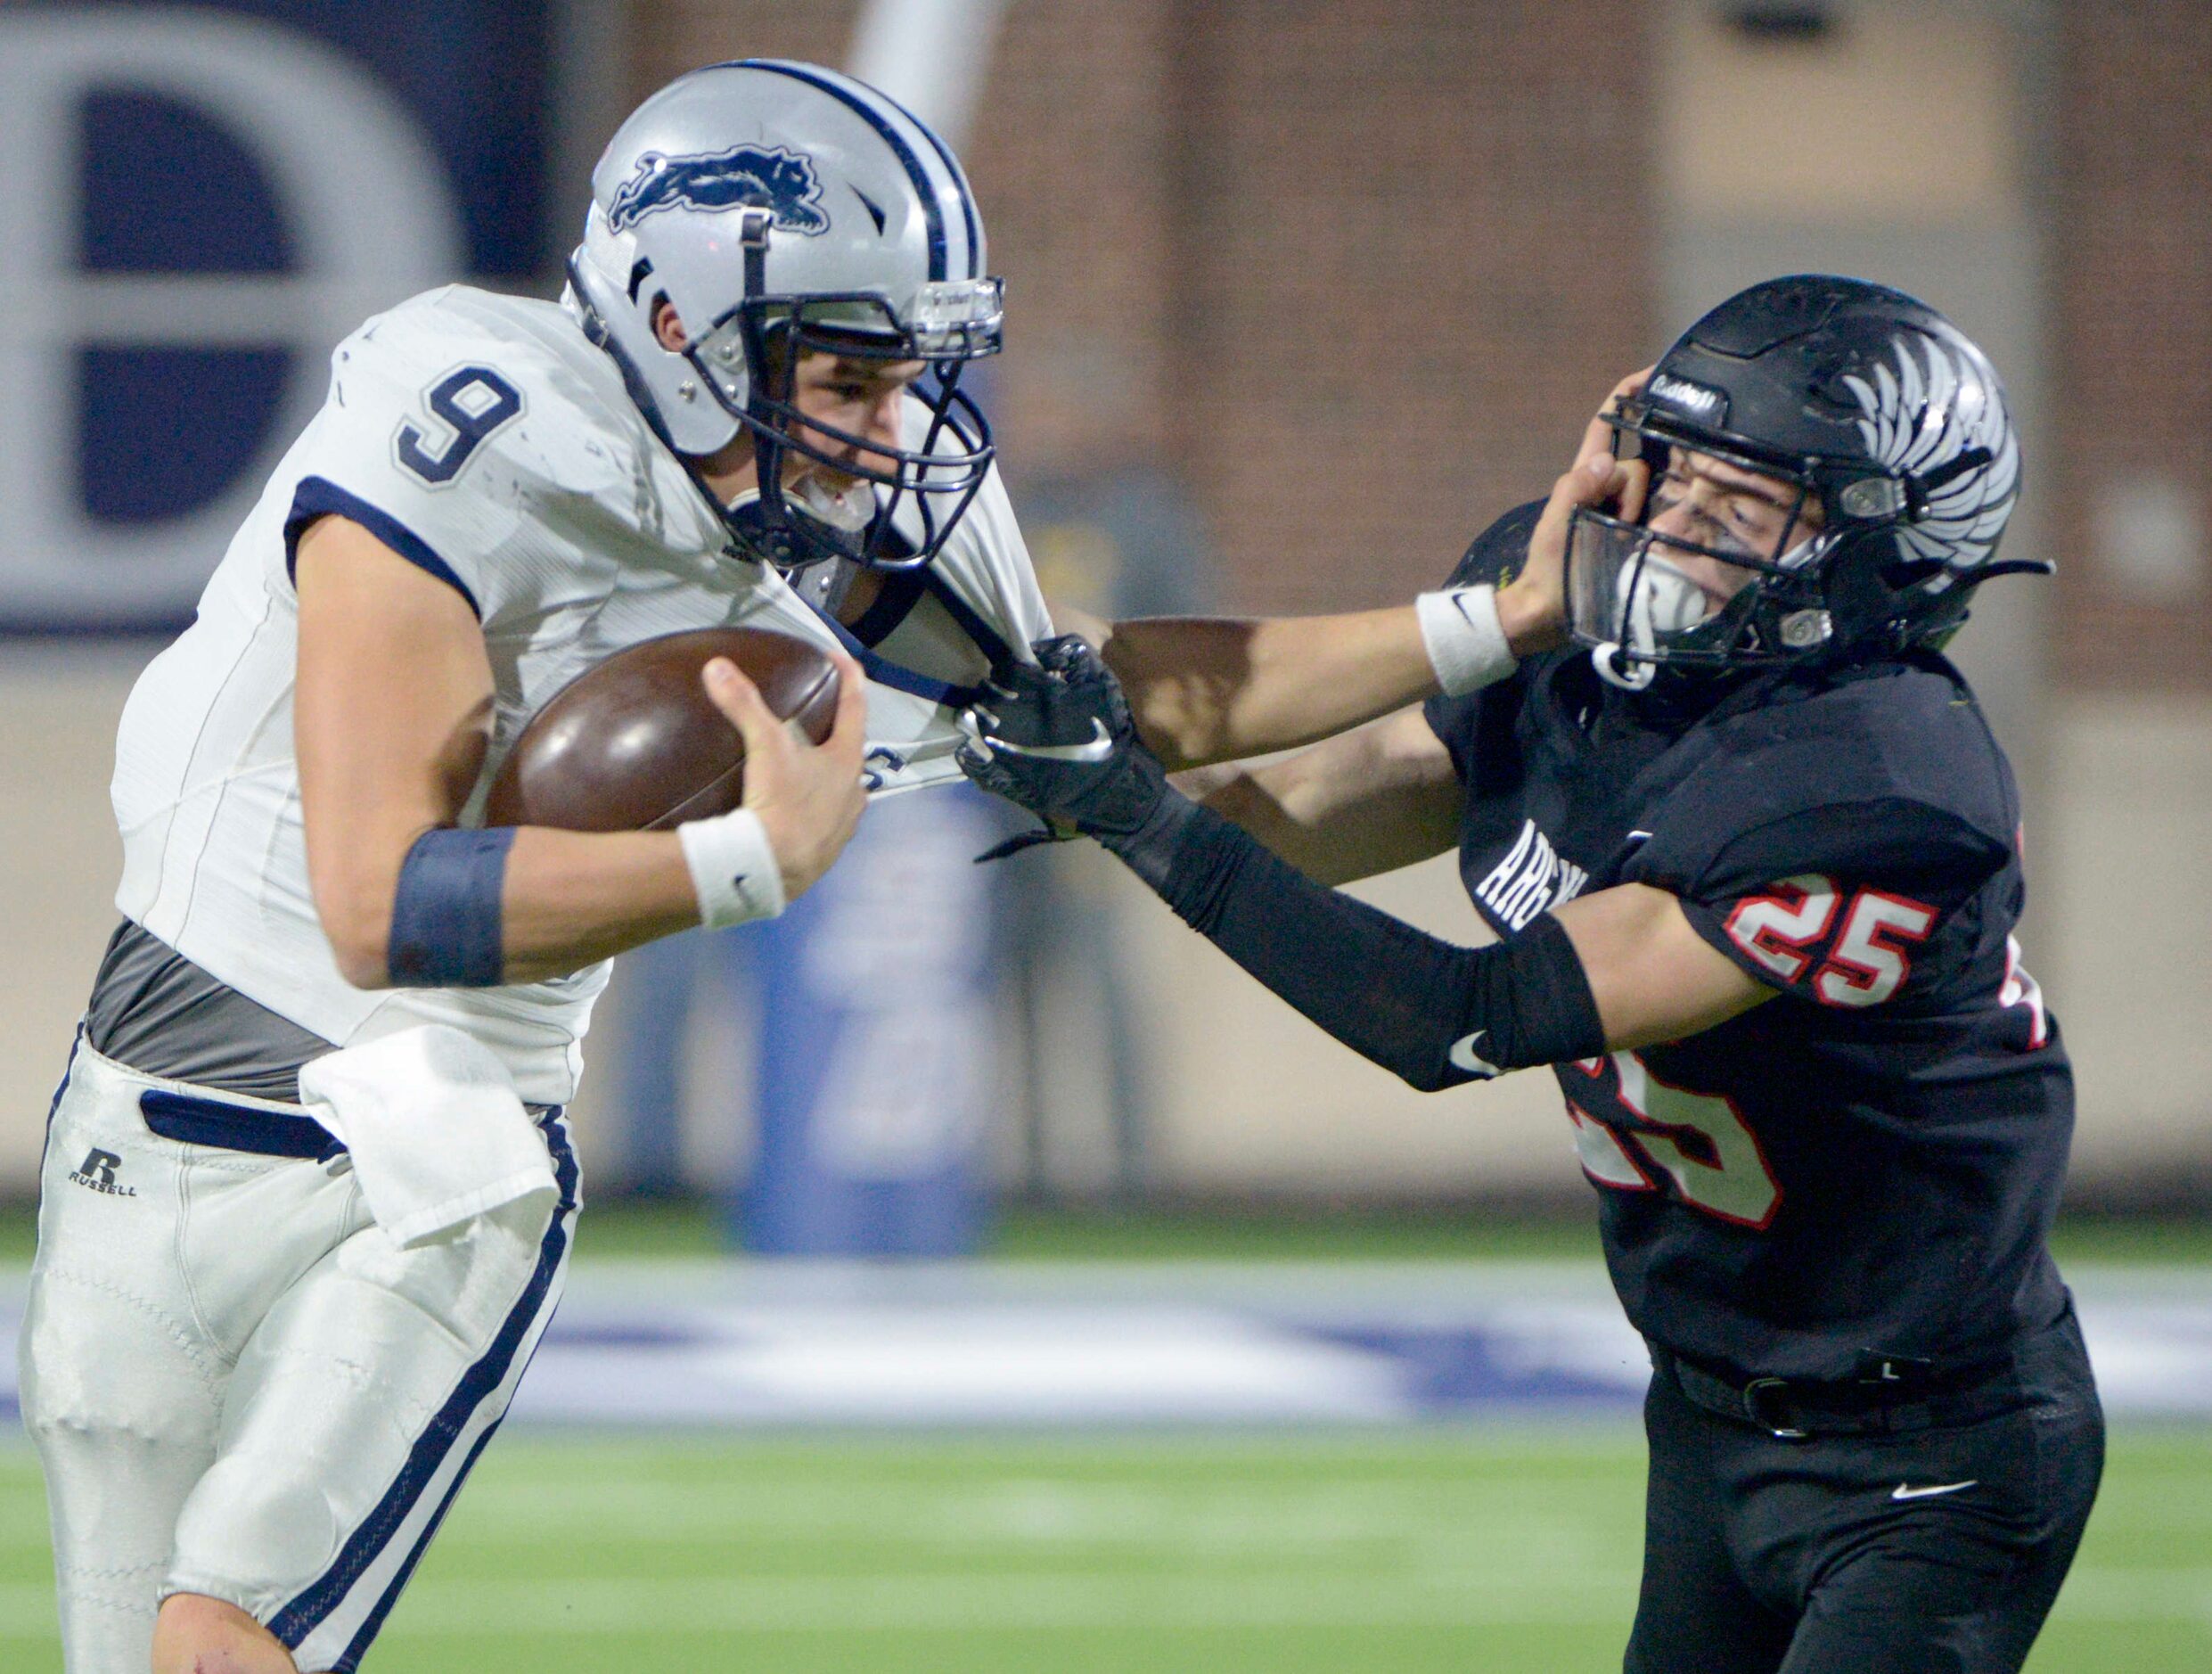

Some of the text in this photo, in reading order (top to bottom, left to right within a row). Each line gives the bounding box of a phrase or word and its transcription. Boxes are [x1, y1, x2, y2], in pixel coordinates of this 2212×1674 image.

[389, 360, 528, 493] 9
[1721, 872, 1941, 1010] 25
[69, 1171, 137, 1197] RUSSELL
[1882, 1361, 1900, 1380] L
